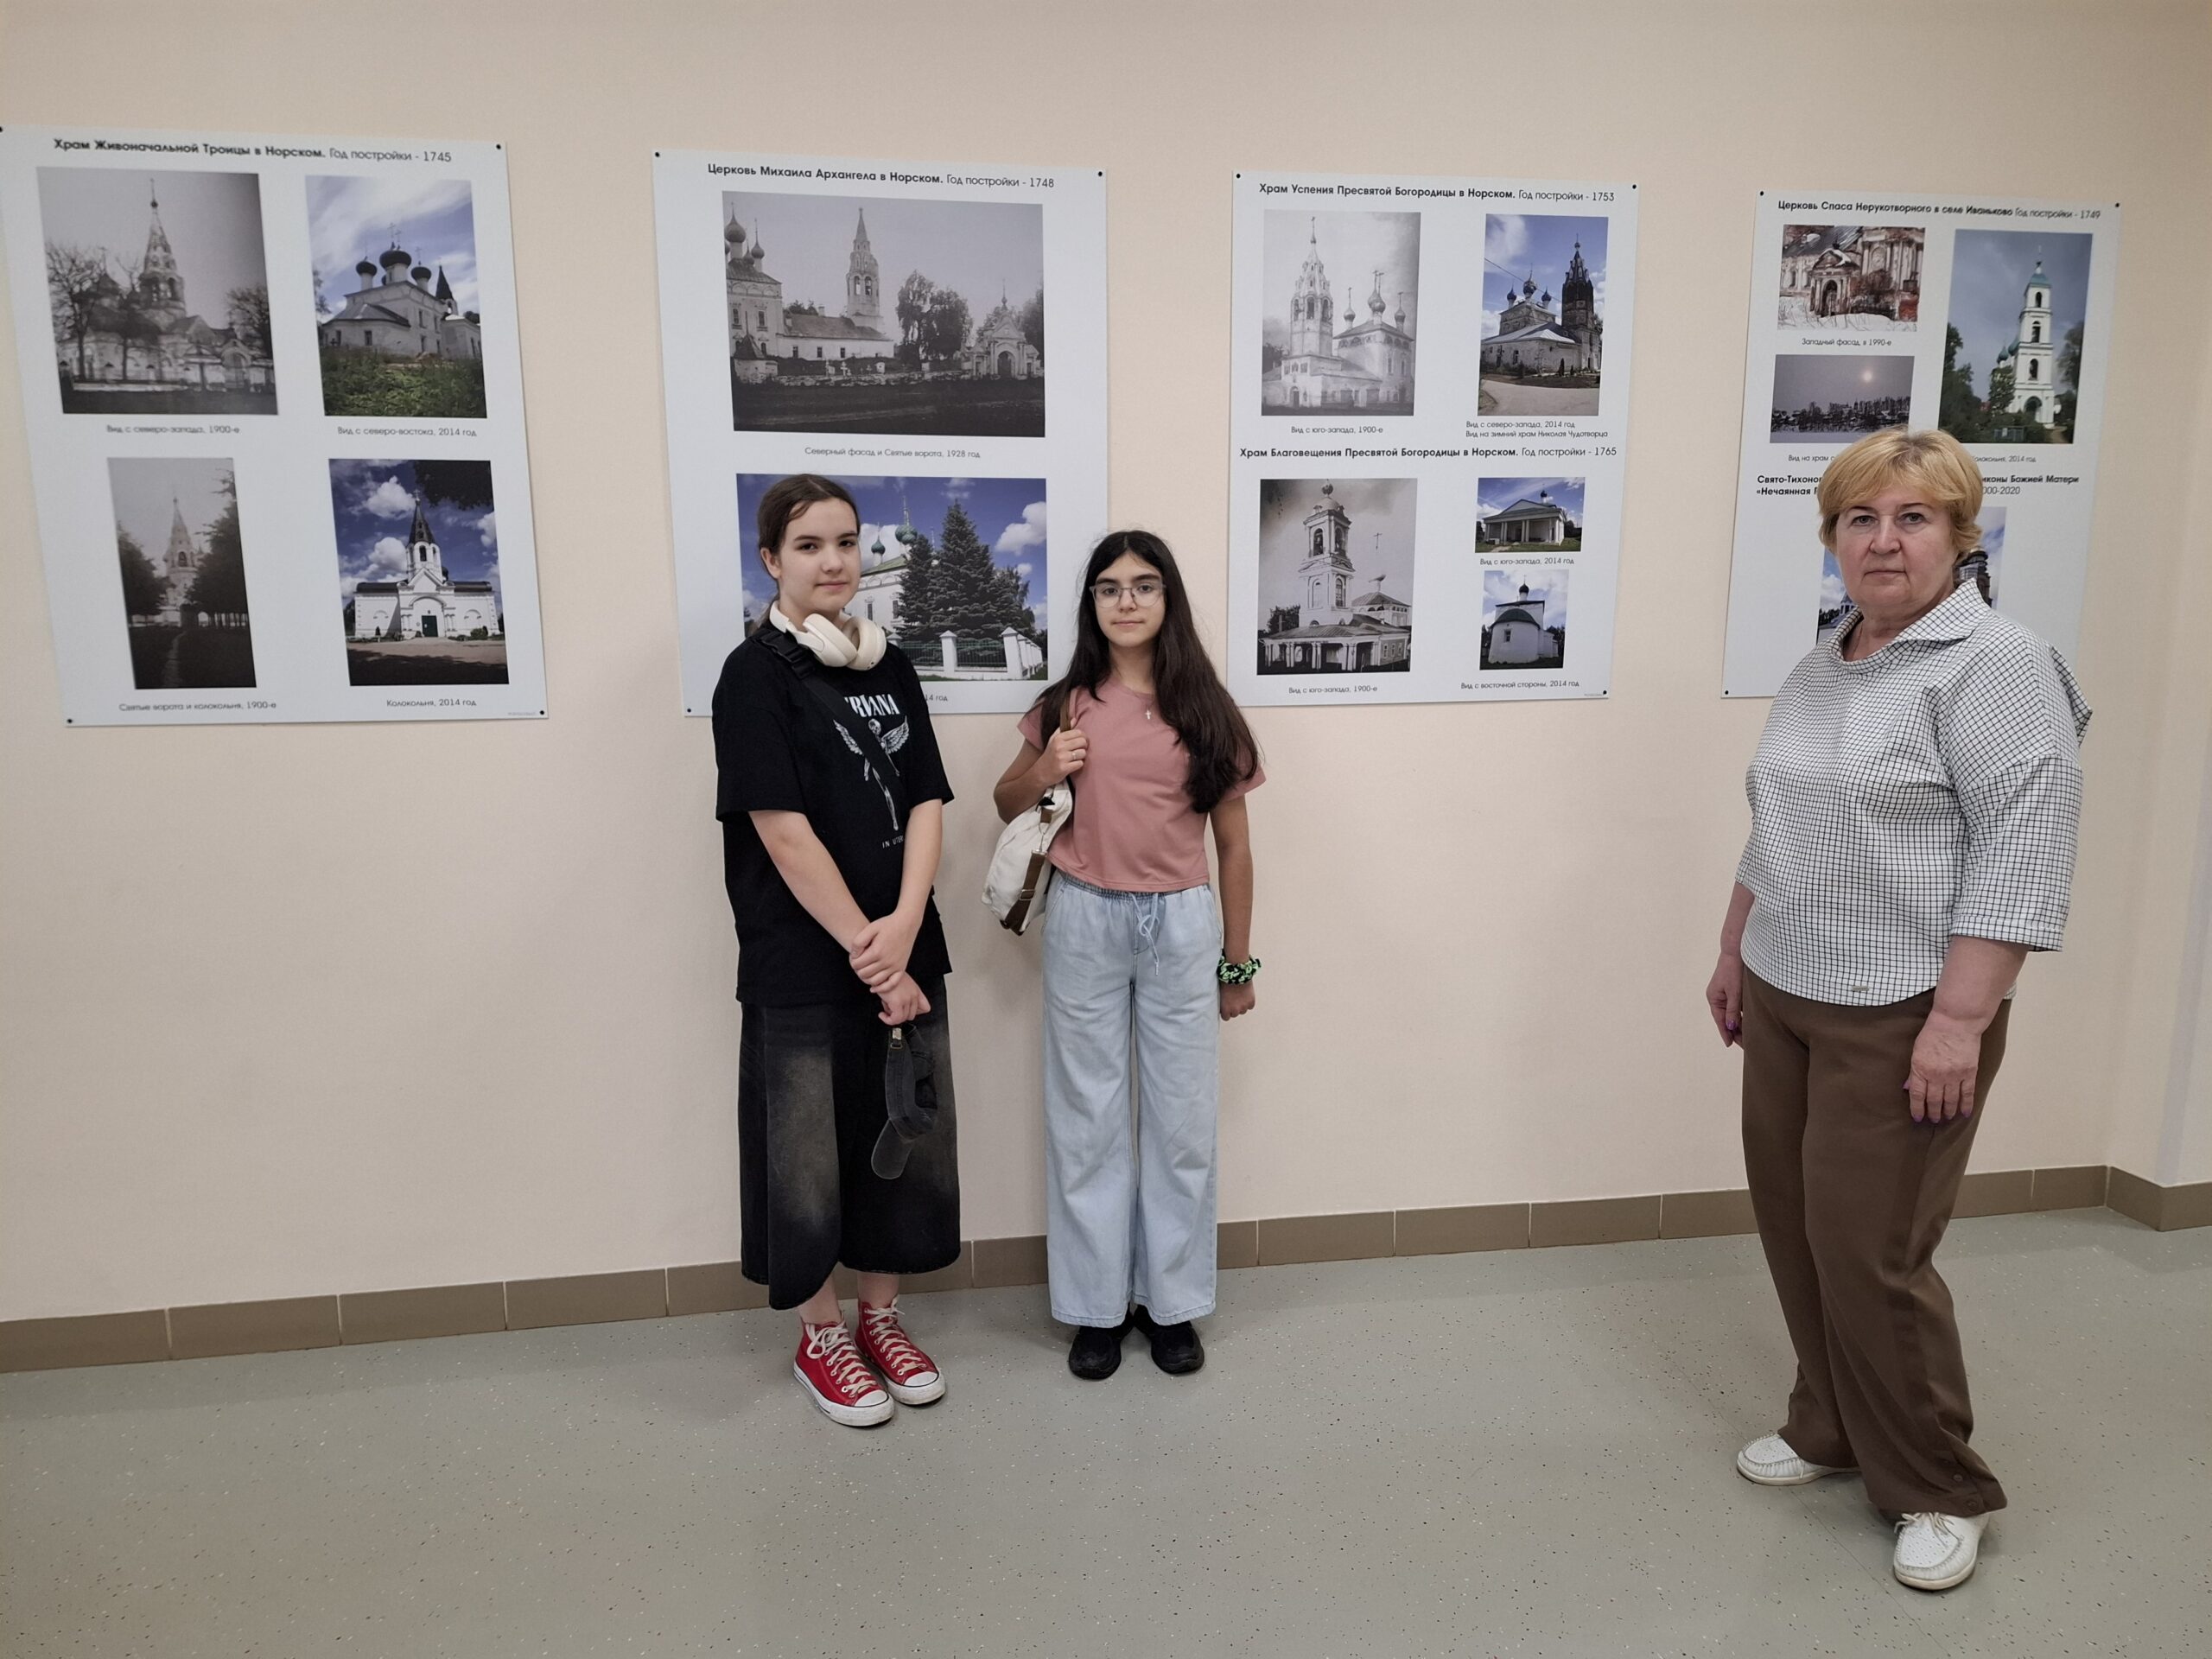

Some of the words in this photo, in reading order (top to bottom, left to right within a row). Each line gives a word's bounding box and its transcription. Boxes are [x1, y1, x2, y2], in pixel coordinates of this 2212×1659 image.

[53, 137, 91, 152] Храм
[93, 139, 200, 154] Живоначальной
[202, 143, 251, 156] Троицы
[254, 147, 262, 156] в
[264, 145, 326, 159] Норском.
[329, 148, 348, 160] Год
[351, 150, 412, 162] постройки
[423, 150, 452, 162] 1745
[708, 163, 757, 177] Церковь
[760, 165, 812, 178] Михаила
[815, 168, 877, 181] Архангела
[880, 173, 887, 181] в
[889, 171, 944, 185] Норском.
[946, 174, 963, 186] Год
[965, 177, 1020, 188] постройки
[1030, 177, 1054, 188] 1748
[1259, 182, 1288, 195] Храм
[1291, 183, 1334, 194] Успения
[1337, 185, 1392, 198] Пресвятой
[1395, 186, 1456, 199] Богородицы
[1467, 188, 1516, 200] Норском.
[1518, 189, 1534, 200] Год
[1535, 192, 1584, 202] постройки
[1592, 192, 1615, 202] 1753
[1777, 200, 1819, 212] Церковь
[1821, 200, 1853, 211] Спаса
[1855, 202, 1932, 214] Нерукотворного
[1942, 206, 1964, 214] селе
[2014, 207, 2029, 218] Год
[2029, 209, 2073, 219] постройки
[1802, 337, 1835, 346] Западный
[1868, 338, 1892, 346] 1990-е
[1465, 420, 1479, 429] Вид
[1544, 420, 1562, 429] 2014
[337, 425, 354, 435] Вид
[438, 427, 461, 436] 2014
[1291, 425, 1305, 435] Вид
[1358, 425, 1383, 434] 1900-е
[1567, 430, 1609, 439] Чудотворца
[804, 447, 847, 457] Северный
[847, 448, 876, 457] фасад
[884, 448, 913, 457] Святые
[947, 449, 966, 458] 1928
[1239, 448, 1268, 460] Храм
[1270, 448, 1342, 458] Благовещения
[1344, 448, 1398, 460] Пресвятой
[1401, 448, 1460, 459] Богородицы
[1471, 447, 1519, 459] Норском.
[1522, 447, 1536, 457] Год
[1538, 448, 1586, 459] постройки
[1594, 447, 1618, 456] 1765
[1788, 454, 1801, 462] Вид
[2008, 454, 2025, 463] 2014
[2010, 474, 2044, 484] Божией
[2045, 474, 2080, 485] Матери
[1756, 486, 1811, 496] «Нечаянная
[1479, 557, 1493, 566] Вид
[1543, 556, 1561, 565] 2014
[1353, 684, 1378, 693] 1900-е
[1460, 682, 1474, 690] Вид
[1480, 681, 1516, 690] восточной
[1549, 679, 1567, 688] 2014
[438, 698, 461, 707] 2014
[844, 694, 900, 717] RVANA
[881, 840, 890, 849] IN
